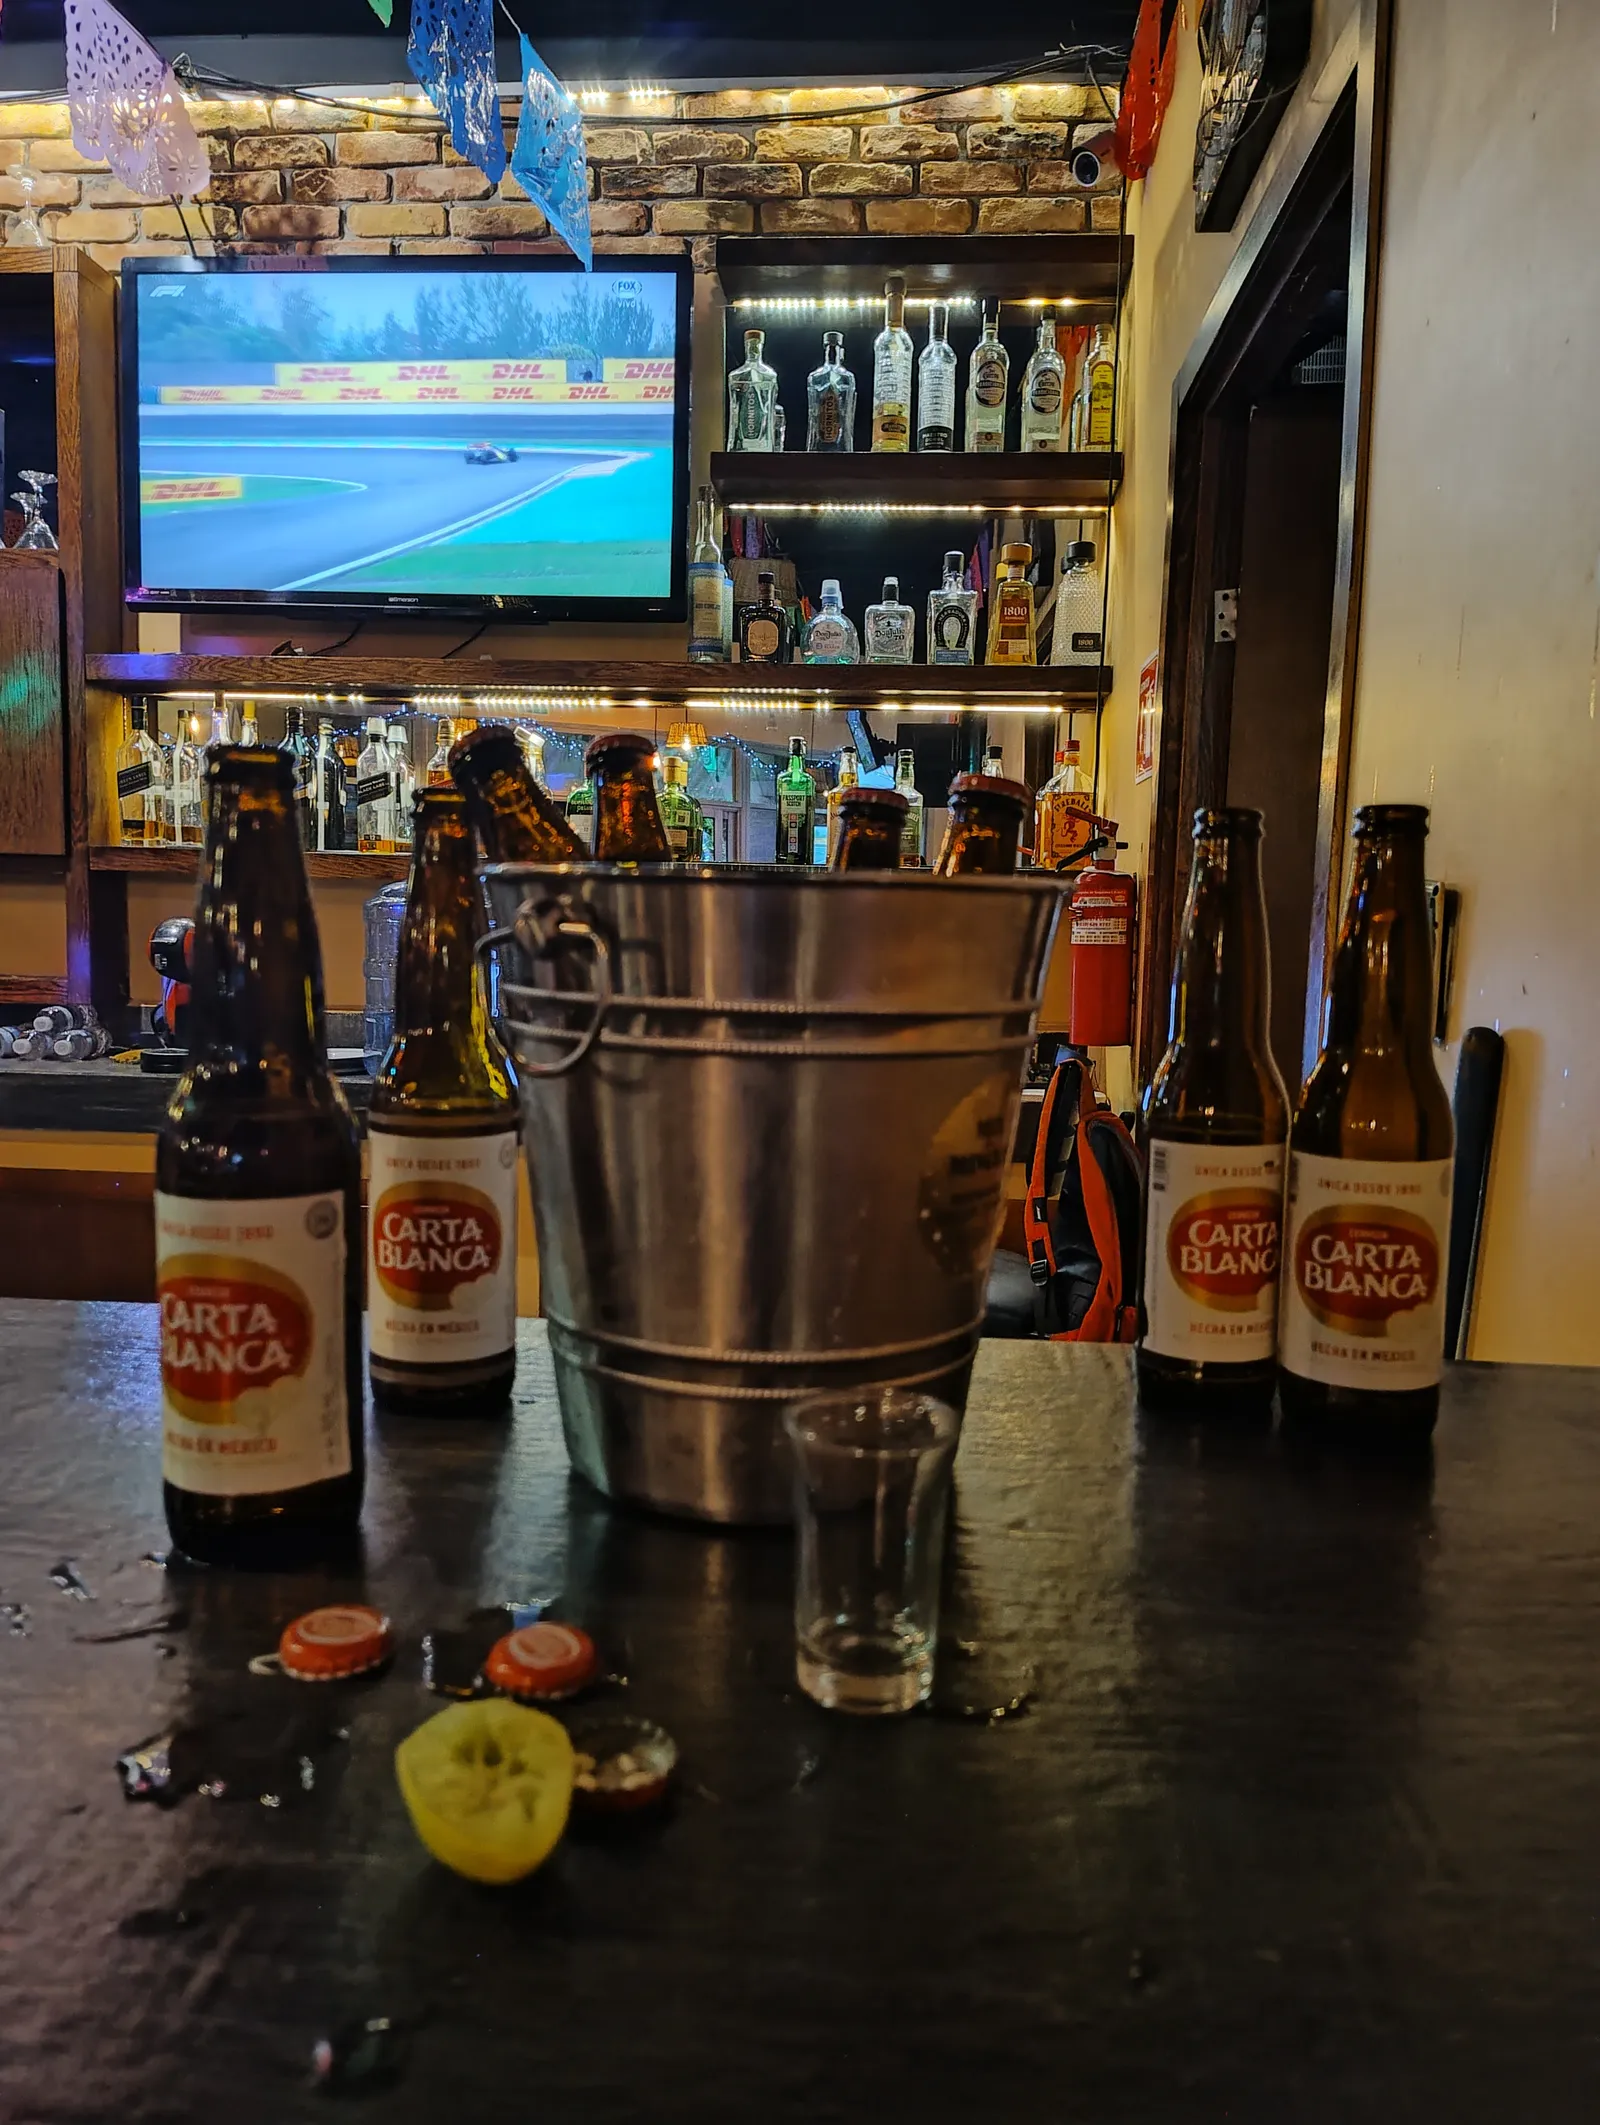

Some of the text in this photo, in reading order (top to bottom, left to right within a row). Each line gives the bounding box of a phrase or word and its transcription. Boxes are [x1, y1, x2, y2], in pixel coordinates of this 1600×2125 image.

[618, 281, 637, 291] FOX
[397, 364, 451, 381] DHL
[491, 363, 545, 380] DHL
[416, 387, 460, 400] DHL
[492, 386, 535, 400] DHL
[568, 386, 612, 400] DHL
[641, 385, 674, 400] DH
[747, 393, 755, 439] HORNITOS
[825, 396, 834, 440] HORNITOS
[1003, 606, 1028, 616] 1800
[782, 794, 805, 802] PASSPORT
[382, 1212, 483, 1246] CARTA
[1188, 1219, 1278, 1249] CARTA
[377, 1239, 491, 1272] BLANCA
[1180, 1244, 1277, 1275] BLANC
[1310, 1234, 1422, 1272] CARTA
[1304, 1259, 1428, 1299] BLANCA
